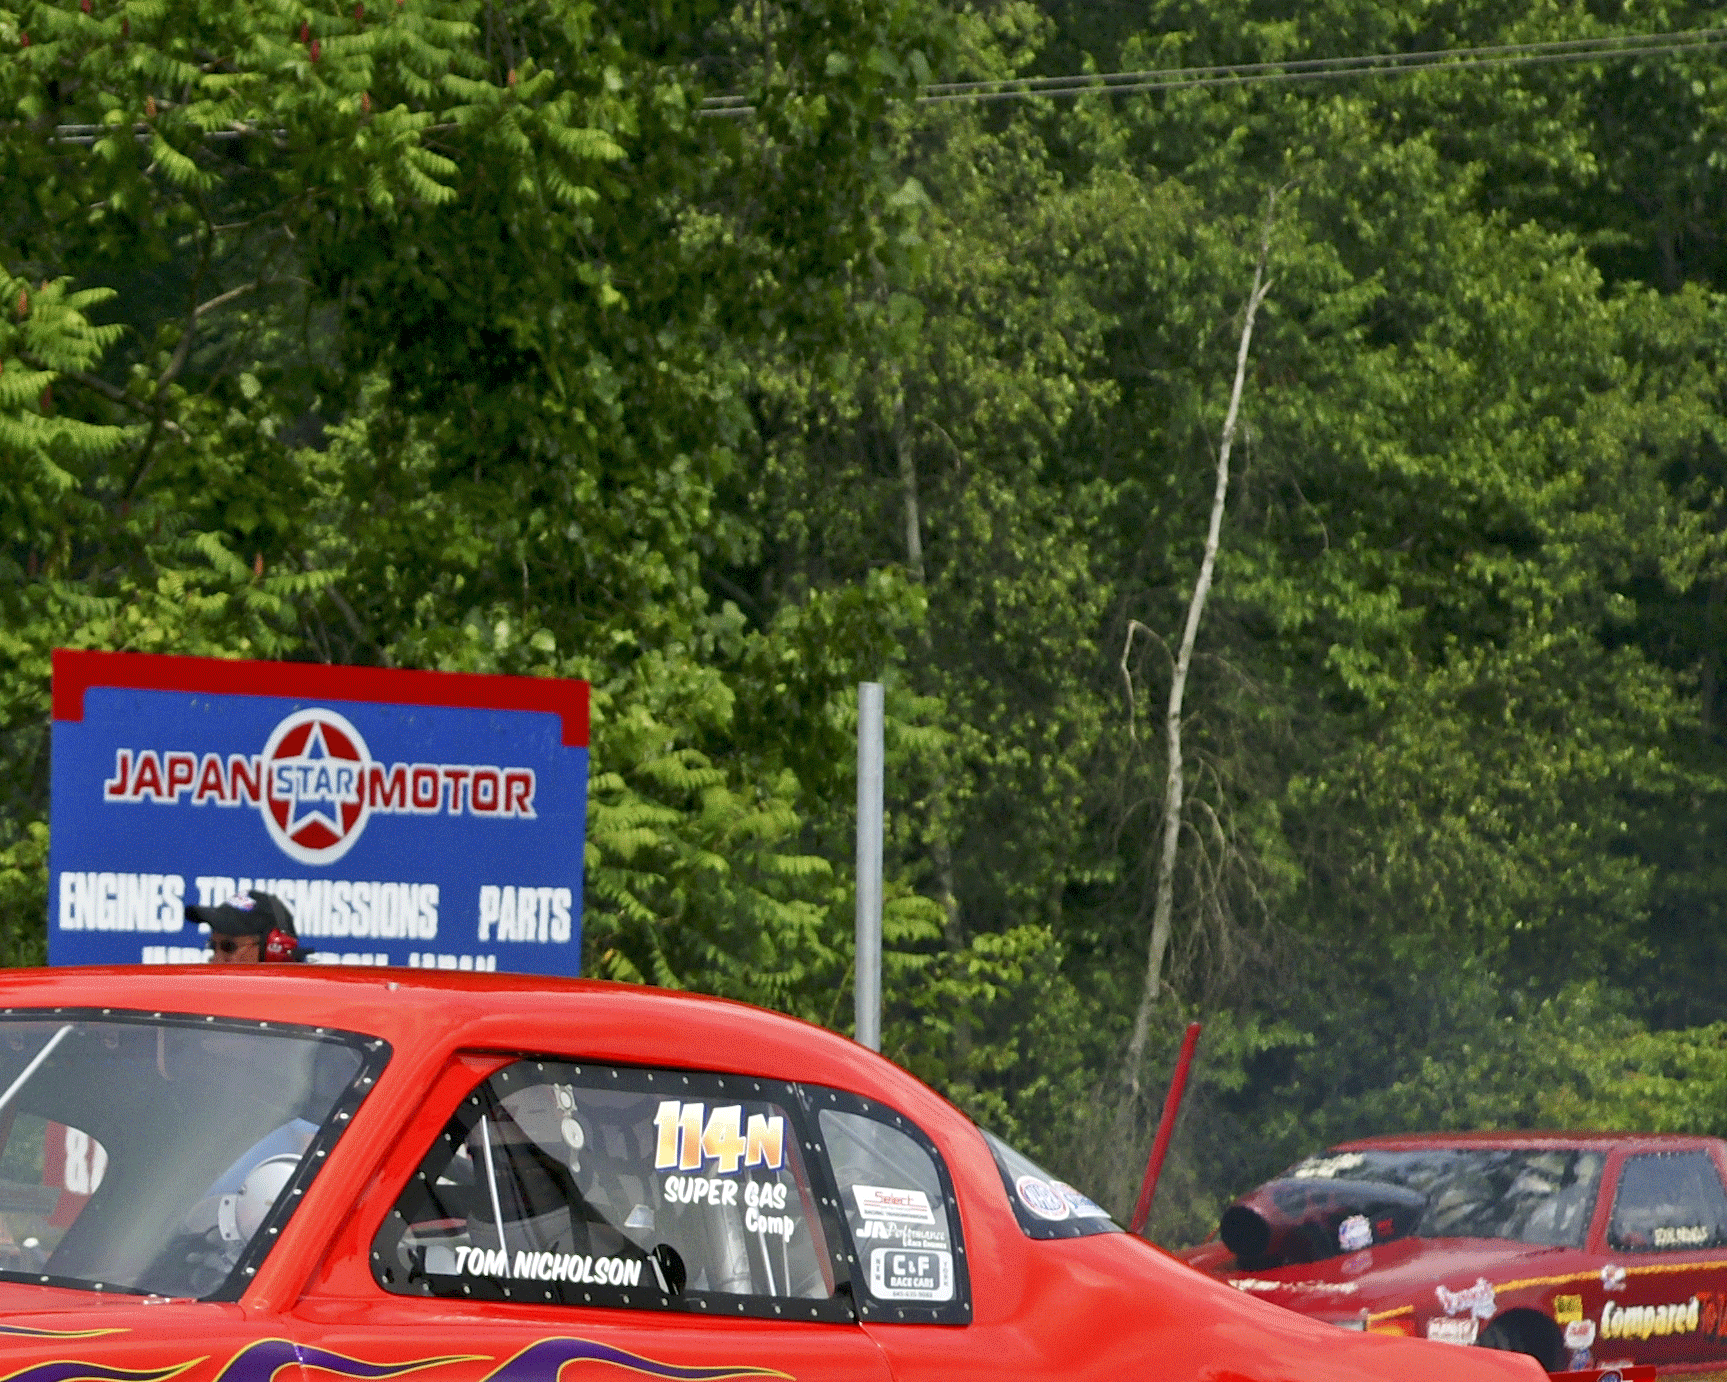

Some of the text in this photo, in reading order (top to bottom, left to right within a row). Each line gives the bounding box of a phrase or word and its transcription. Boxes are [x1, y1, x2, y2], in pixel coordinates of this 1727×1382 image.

[105, 749, 537, 819] JAPAN STAR MOTOR
[59, 871, 185, 932] ENGINES
[195, 875, 440, 940] TRSMISSIONS
[478, 885, 572, 943] PARTS
[653, 1099, 786, 1173] 114N
[663, 1175, 787, 1210] SUPER GAS
[745, 1206, 795, 1243] Comp
[455, 1245, 642, 1287] TOM NICHOLSON
[890, 1276, 934, 1288] RACE CARS
[1600, 1296, 1699, 1341] Compared
